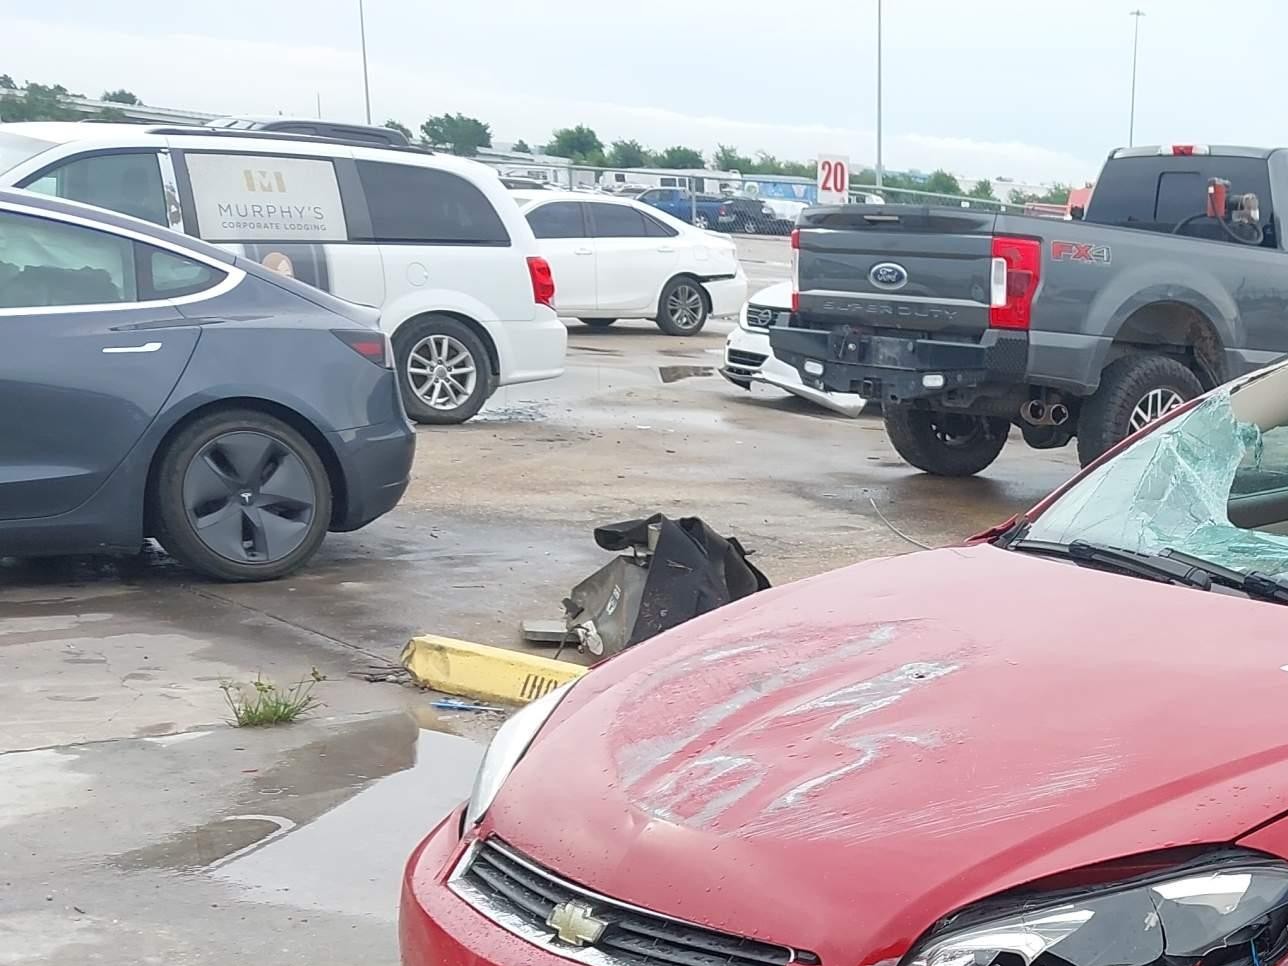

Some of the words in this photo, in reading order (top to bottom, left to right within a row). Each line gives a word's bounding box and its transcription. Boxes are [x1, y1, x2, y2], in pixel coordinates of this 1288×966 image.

[821, 160, 845, 193] 20
[217, 203, 324, 220] MURPHY'S
[222, 221, 281, 231] CORPORATE
[284, 222, 327, 231] LODGING
[1051, 240, 1112, 265] FX4
[823, 299, 894, 315] SUPER
[896, 305, 959, 321] DUTY
